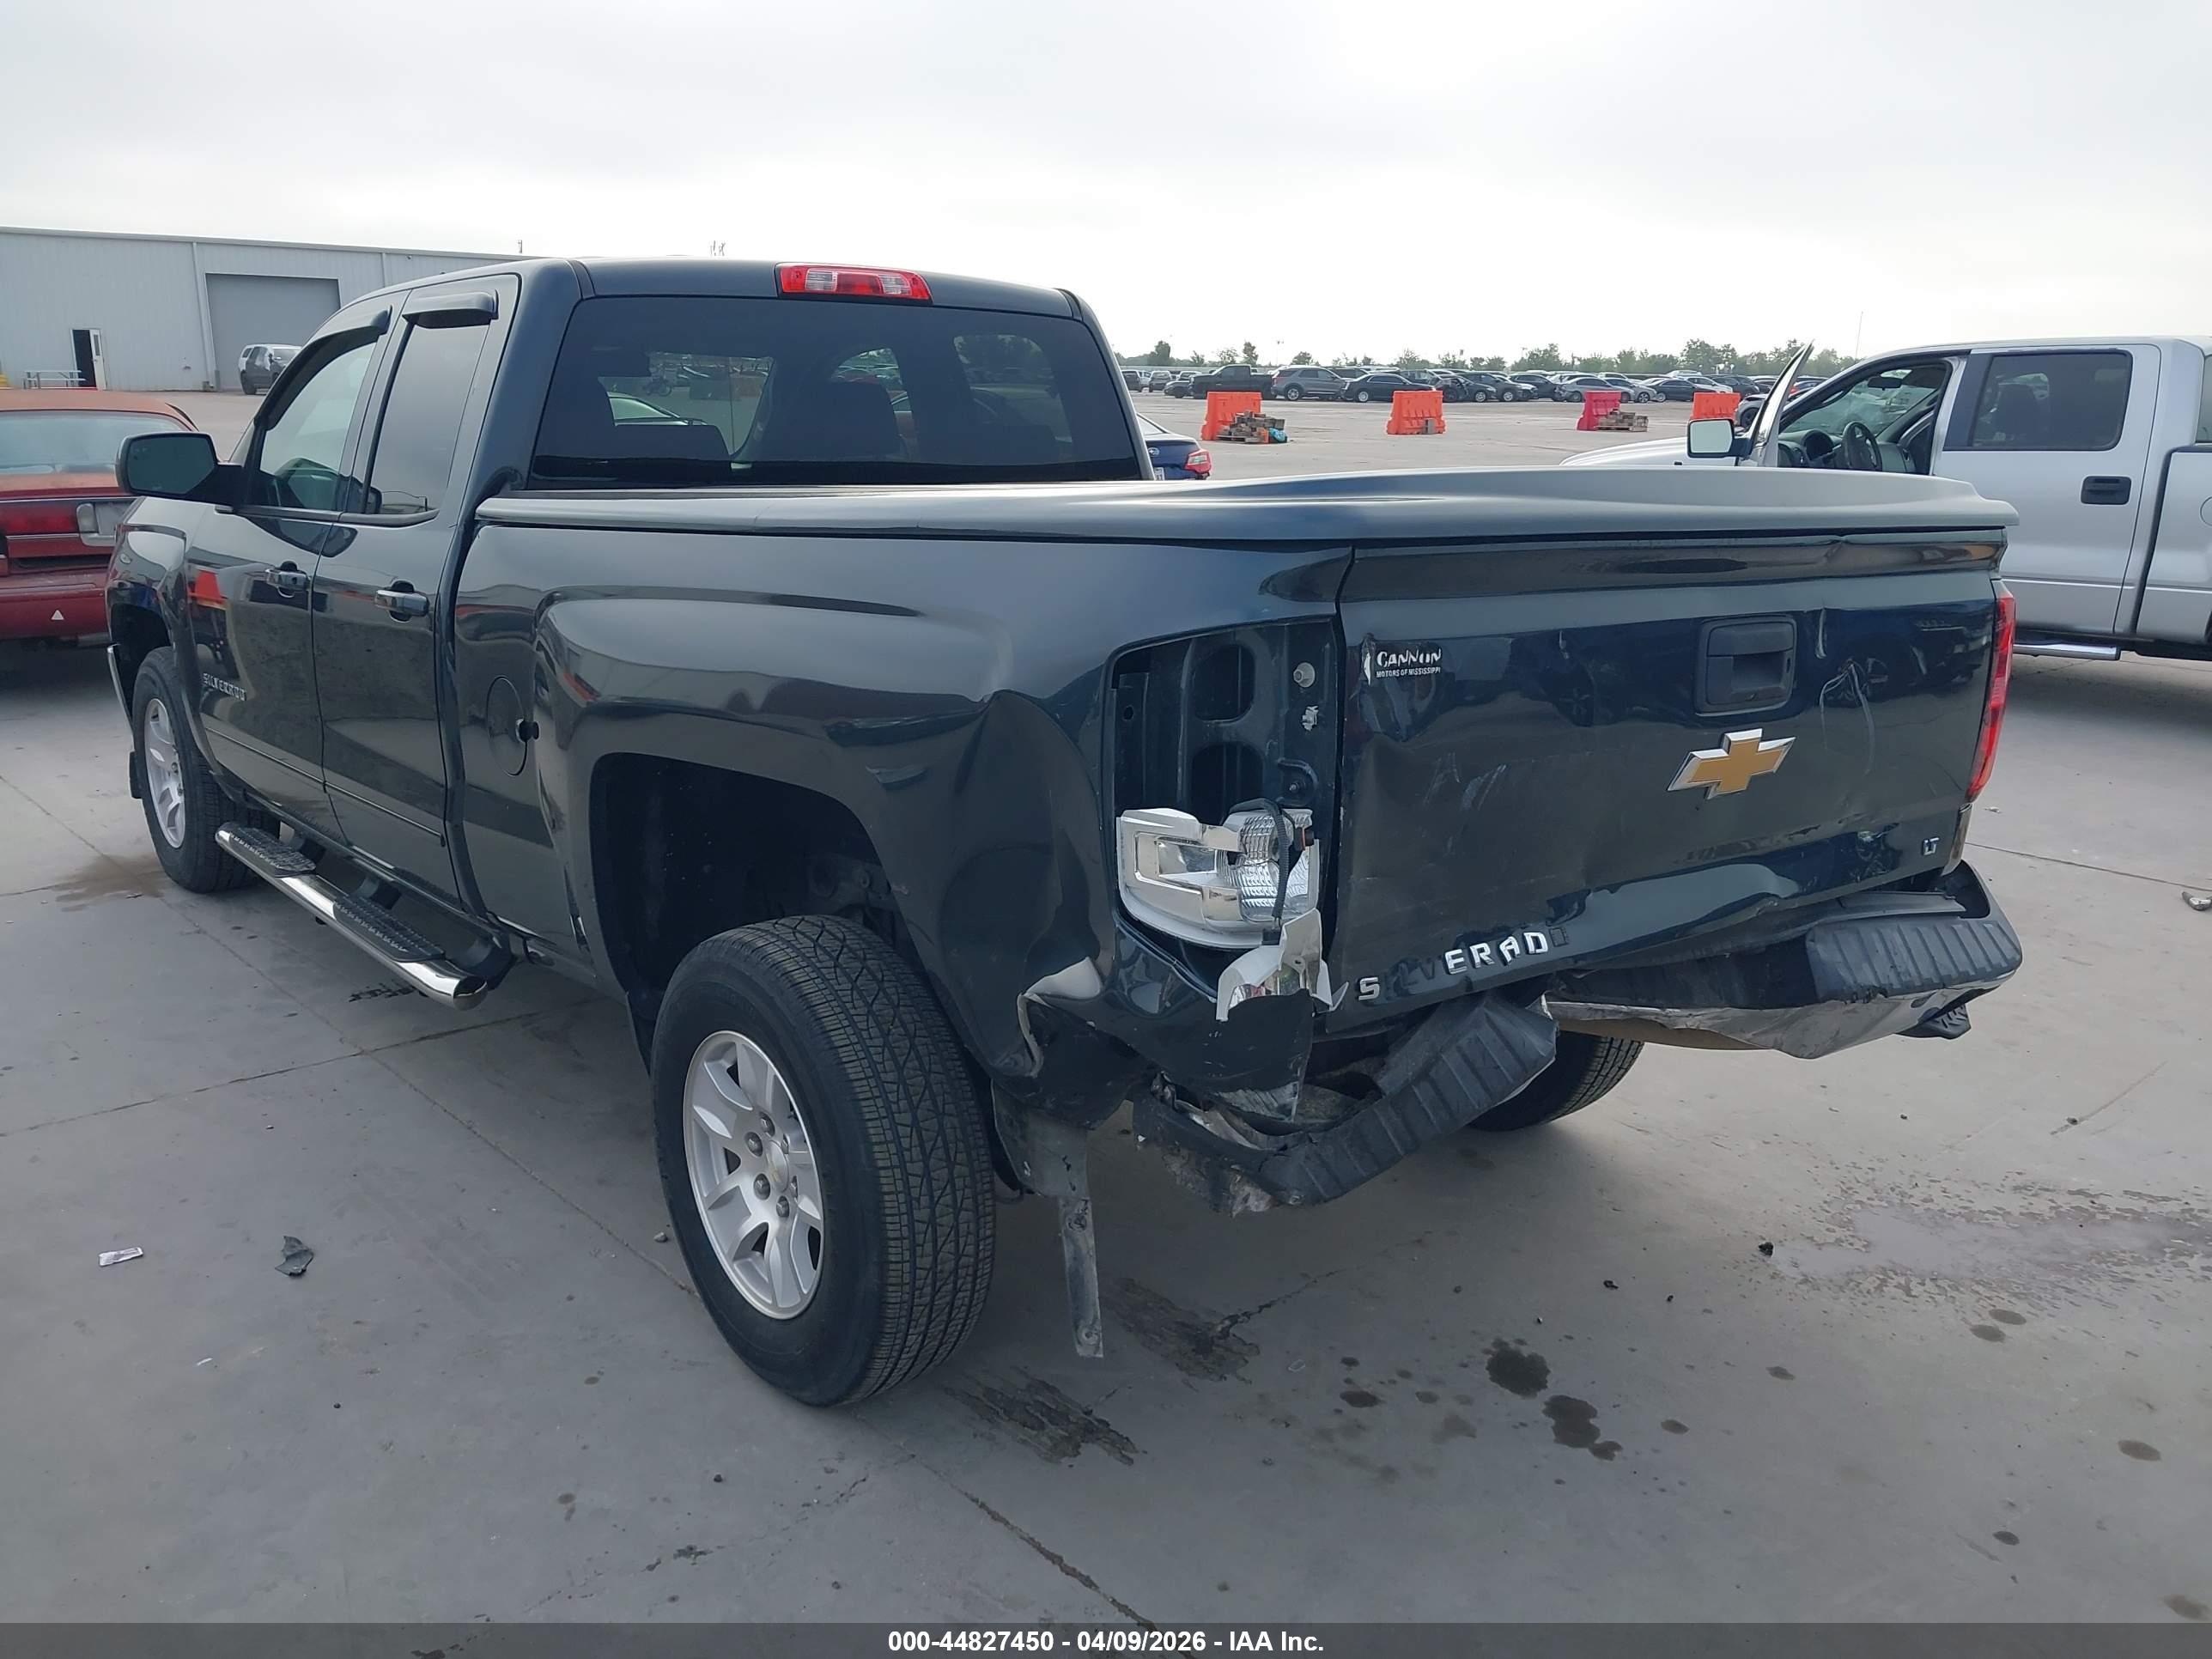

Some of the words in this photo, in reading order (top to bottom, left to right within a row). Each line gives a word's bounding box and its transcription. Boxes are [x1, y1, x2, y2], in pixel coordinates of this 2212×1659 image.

[1376, 647, 1442, 667] CANNON
[1376, 669, 1400, 678] MOTORS
[1408, 666, 1441, 676] MISSISSIPPI
[1923, 837, 1940, 855] LT
